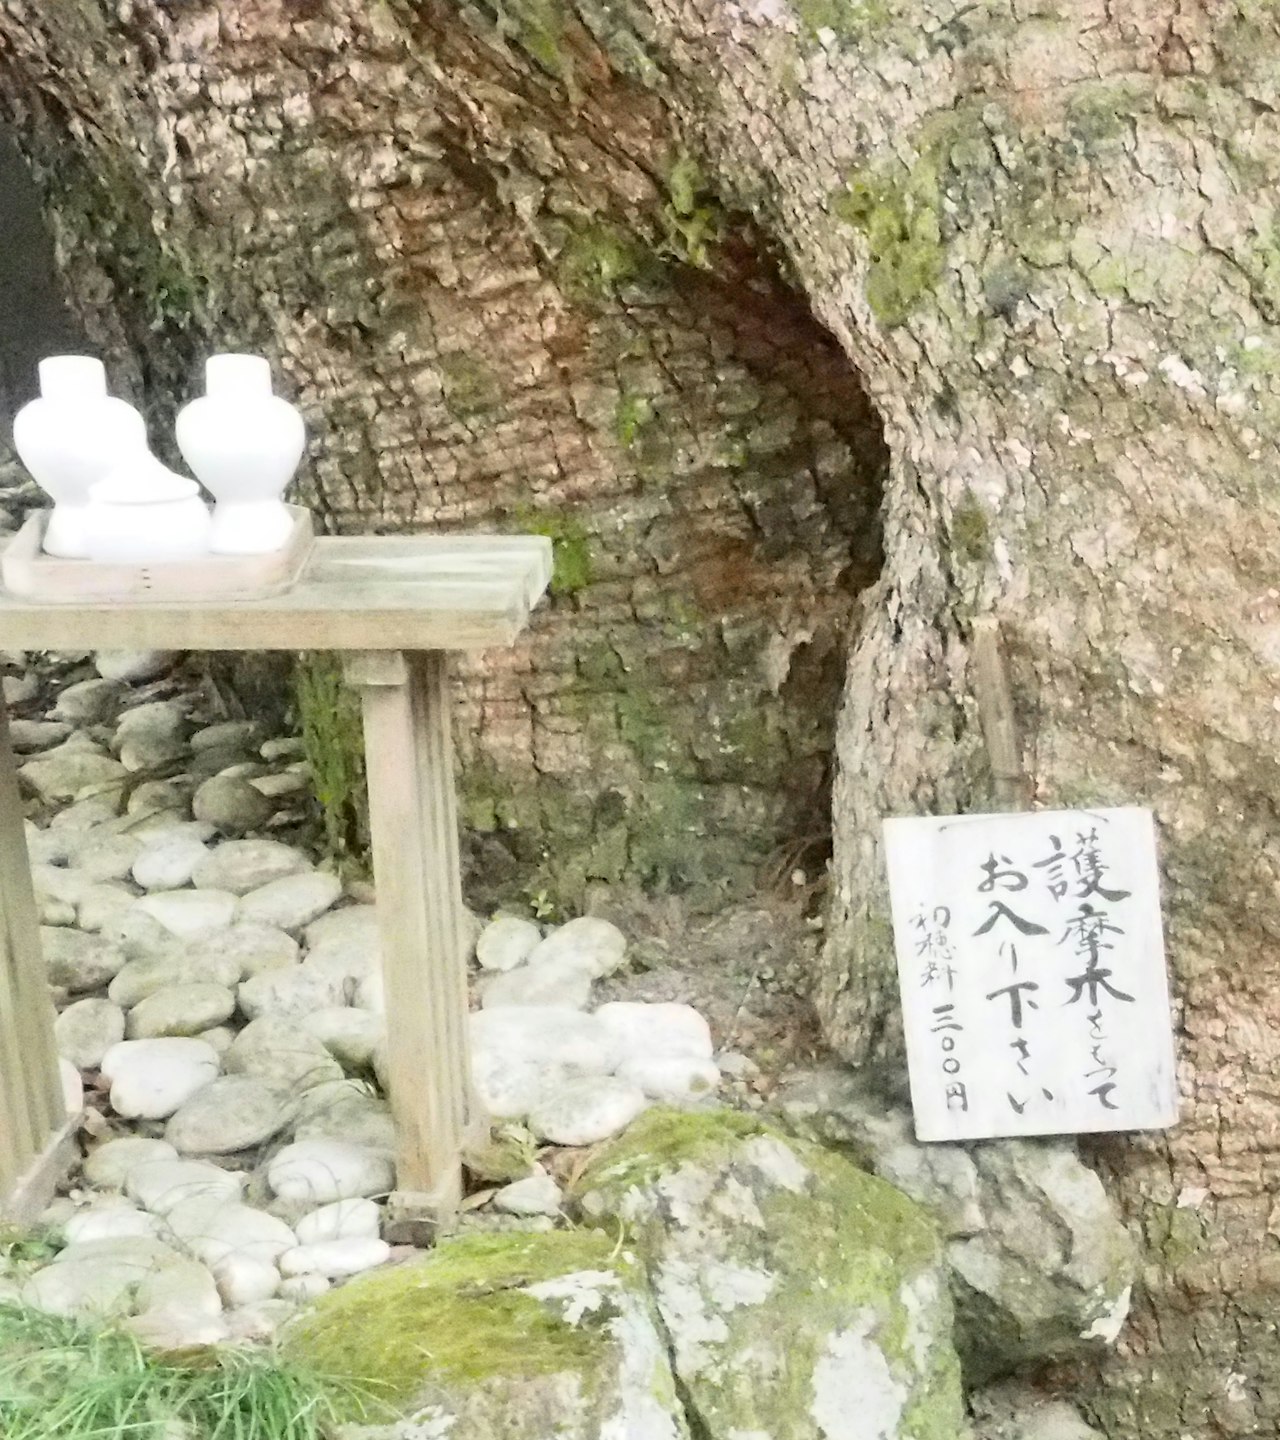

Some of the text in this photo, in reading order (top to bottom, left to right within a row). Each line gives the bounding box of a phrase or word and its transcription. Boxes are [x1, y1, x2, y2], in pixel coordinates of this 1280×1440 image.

[971, 851, 1054, 1114] お入り下さい
